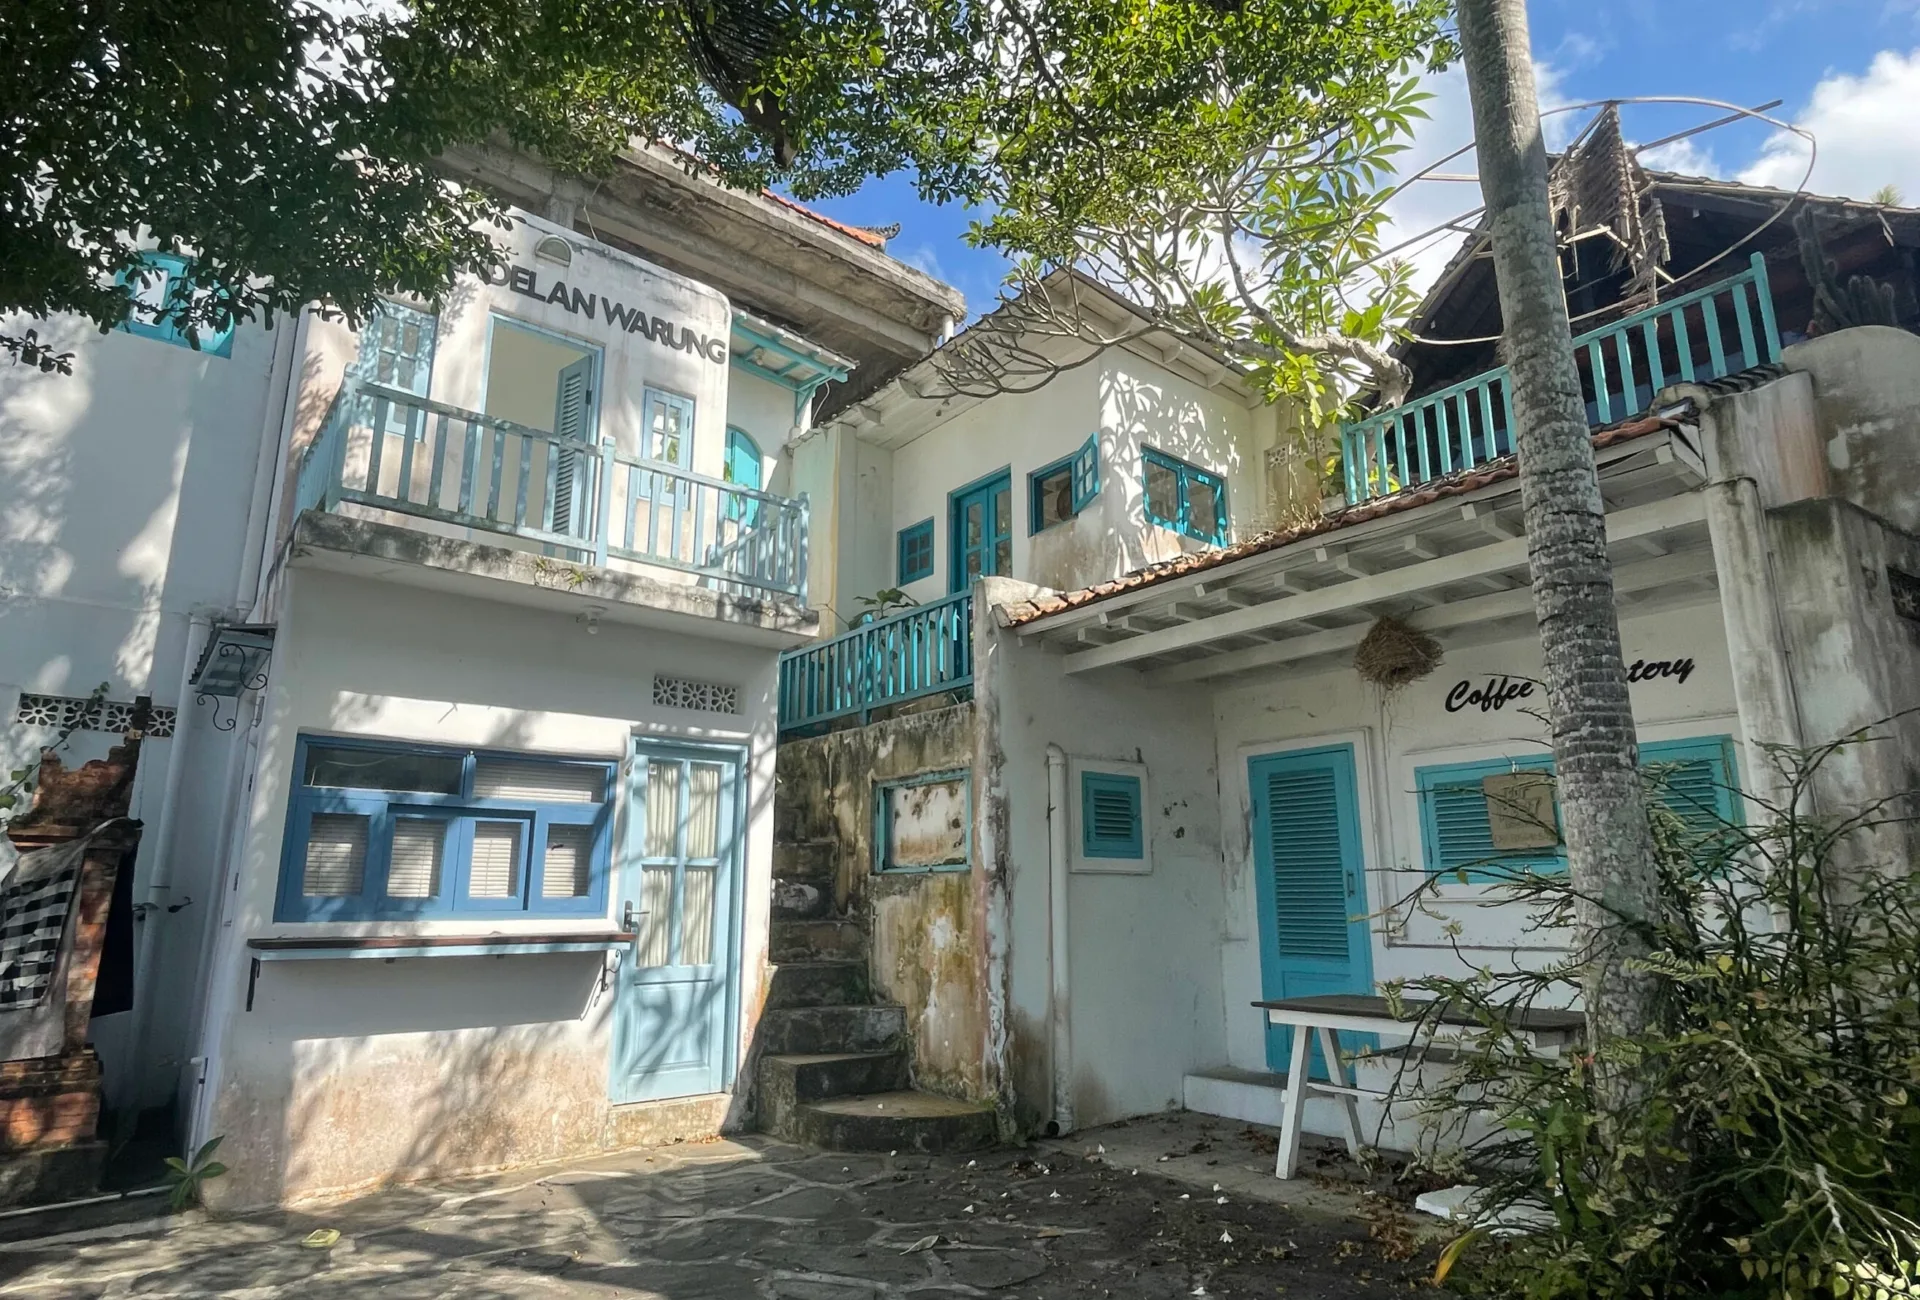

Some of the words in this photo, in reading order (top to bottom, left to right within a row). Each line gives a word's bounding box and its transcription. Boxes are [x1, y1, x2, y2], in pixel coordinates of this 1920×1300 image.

[601, 296, 726, 364] WARUNG
[1444, 678, 1534, 713] Coffee
[1623, 658, 1695, 684] tery
